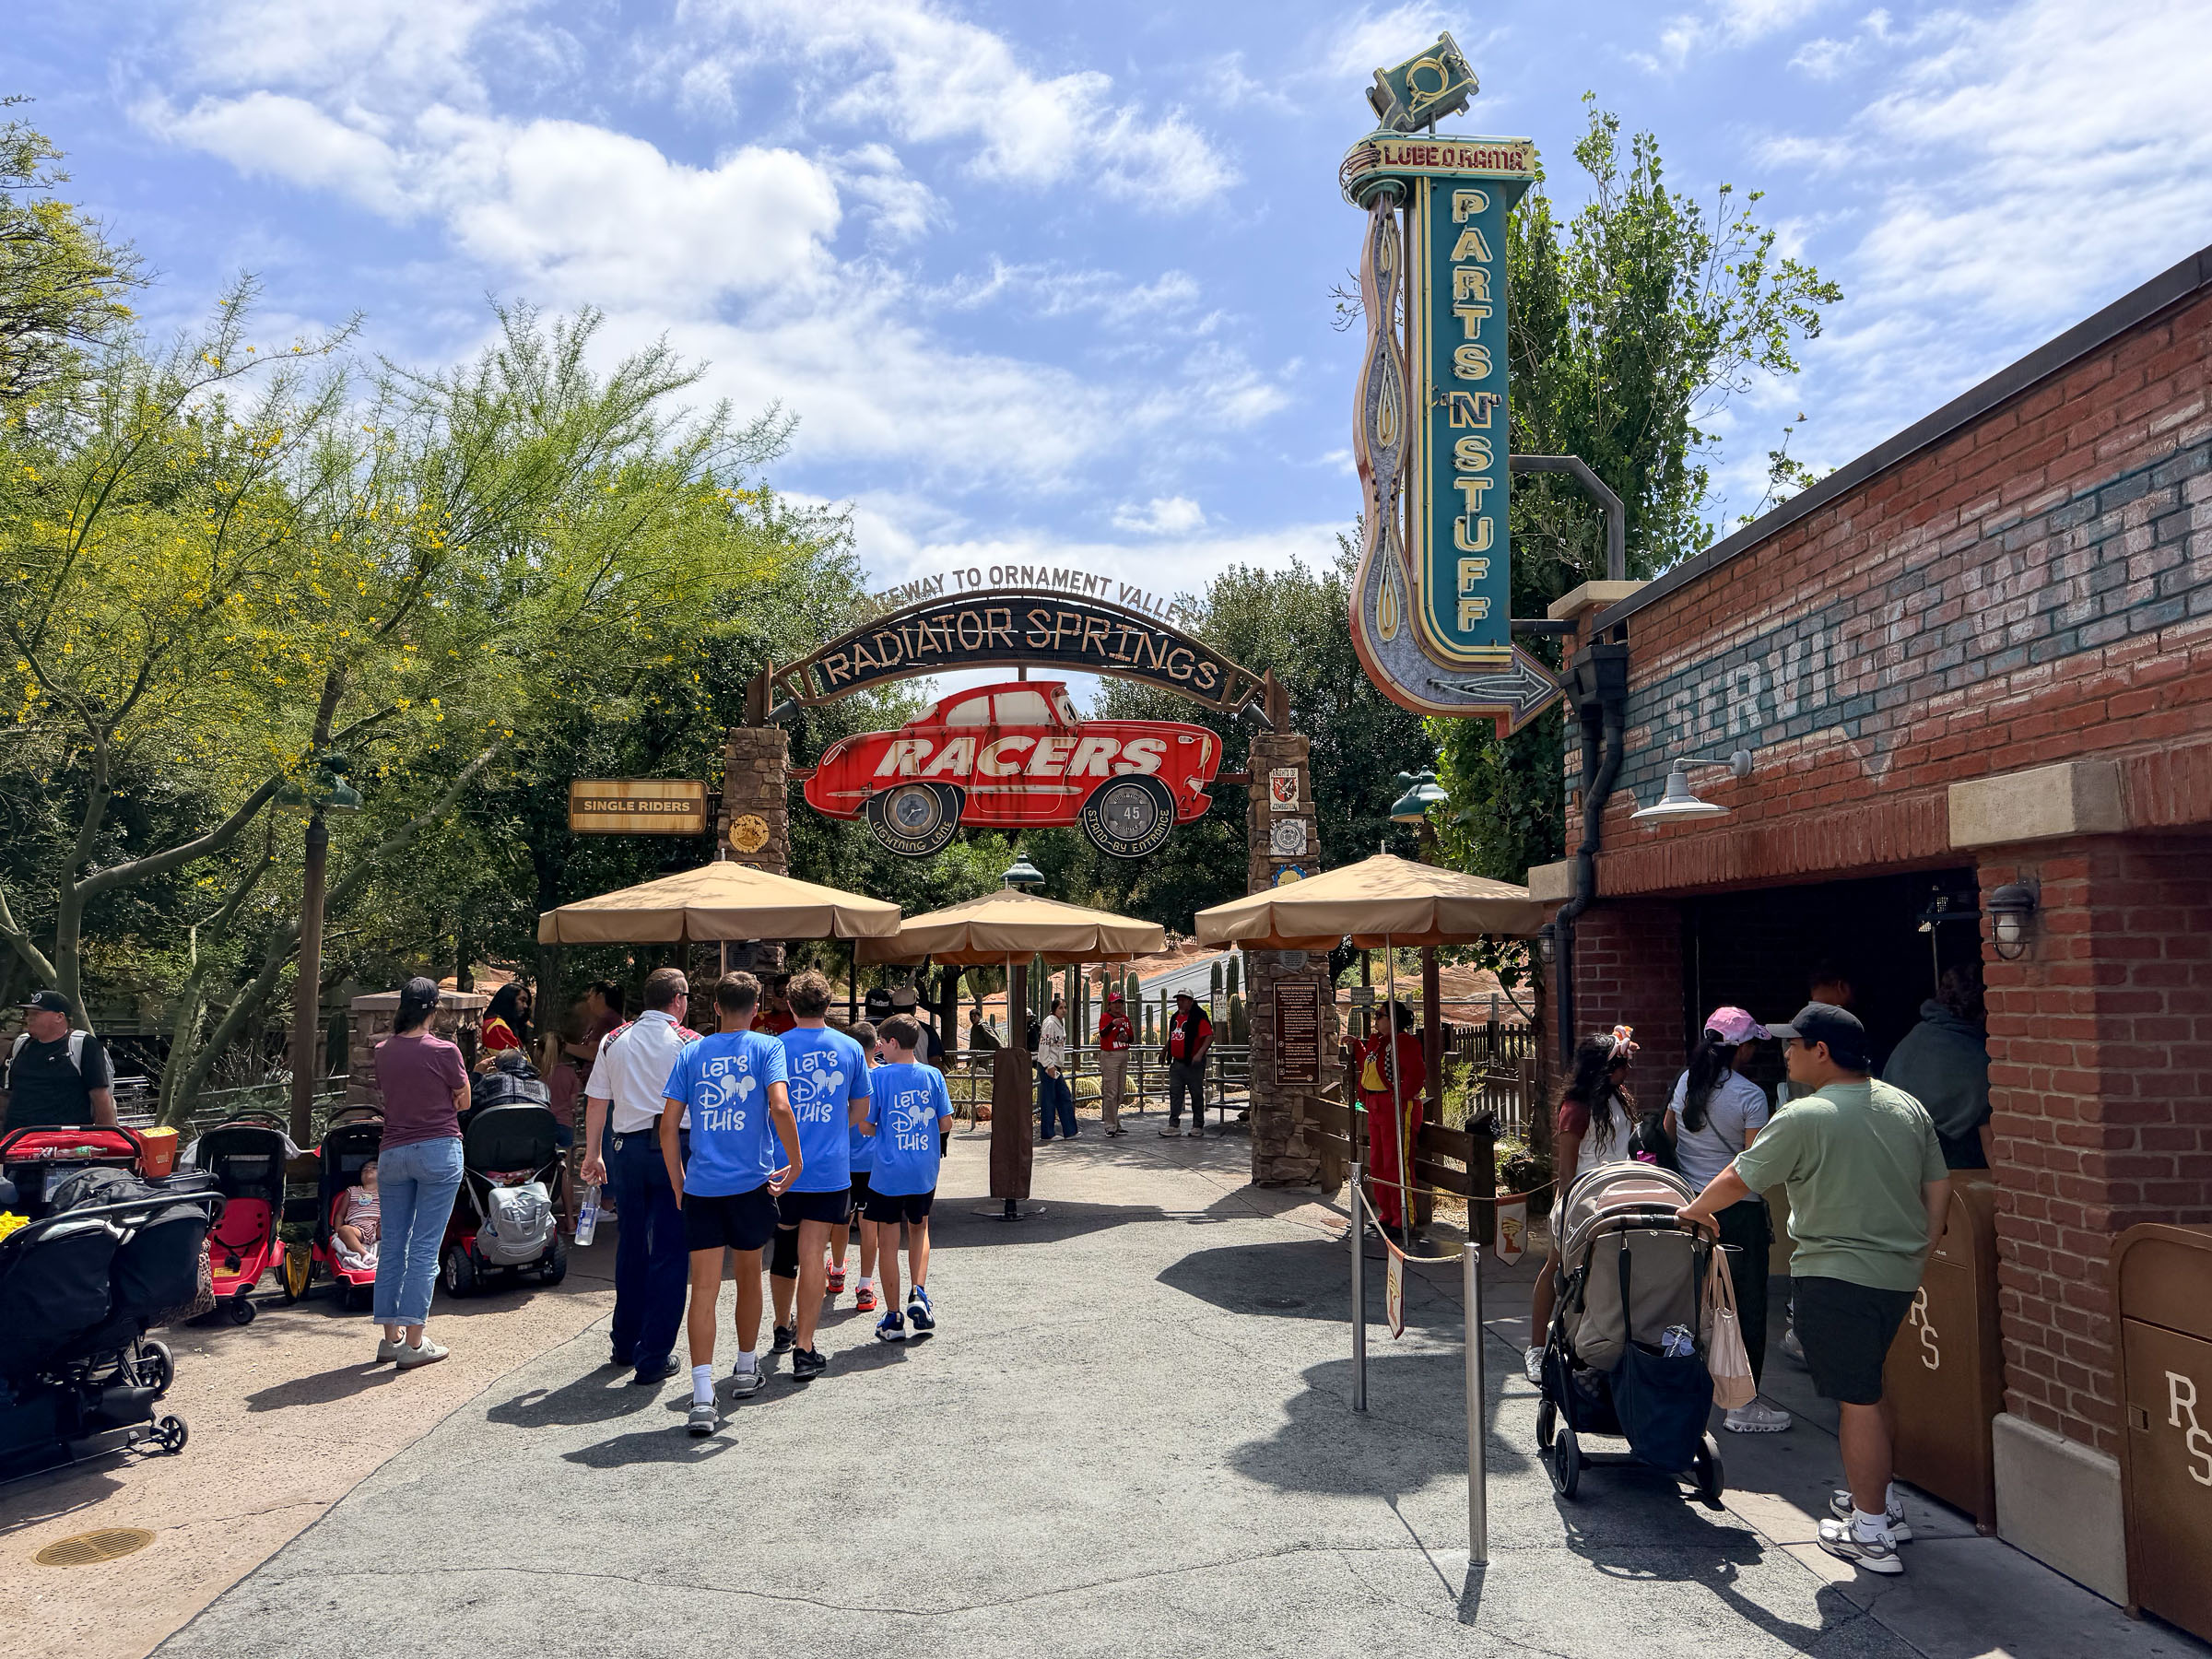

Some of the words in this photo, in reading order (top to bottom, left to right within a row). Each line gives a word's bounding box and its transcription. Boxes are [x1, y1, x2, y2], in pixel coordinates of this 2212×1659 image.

[1451, 189, 1493, 380] PARTS
[1453, 435, 1494, 632] STUFF
[850, 573, 945, 623] GATEWAY
[952, 567, 982, 590] TO
[989, 565, 1112, 596] ORNAMENT
[1119, 582, 1195, 625] VALLEY
[821, 607, 1014, 686] RADIATOR
[1026, 608, 1219, 690] SPRINGS
[873, 735, 1168, 777] RACERS
[583, 800, 635, 812] SINGLE
[638, 801, 690, 812] RIDERS
[1124, 806, 1140, 819] 45
[873, 821, 927, 852] LIGHTNING
[930, 820, 953, 845] LANE
[1132, 809, 1170, 853] ENTRANCE
